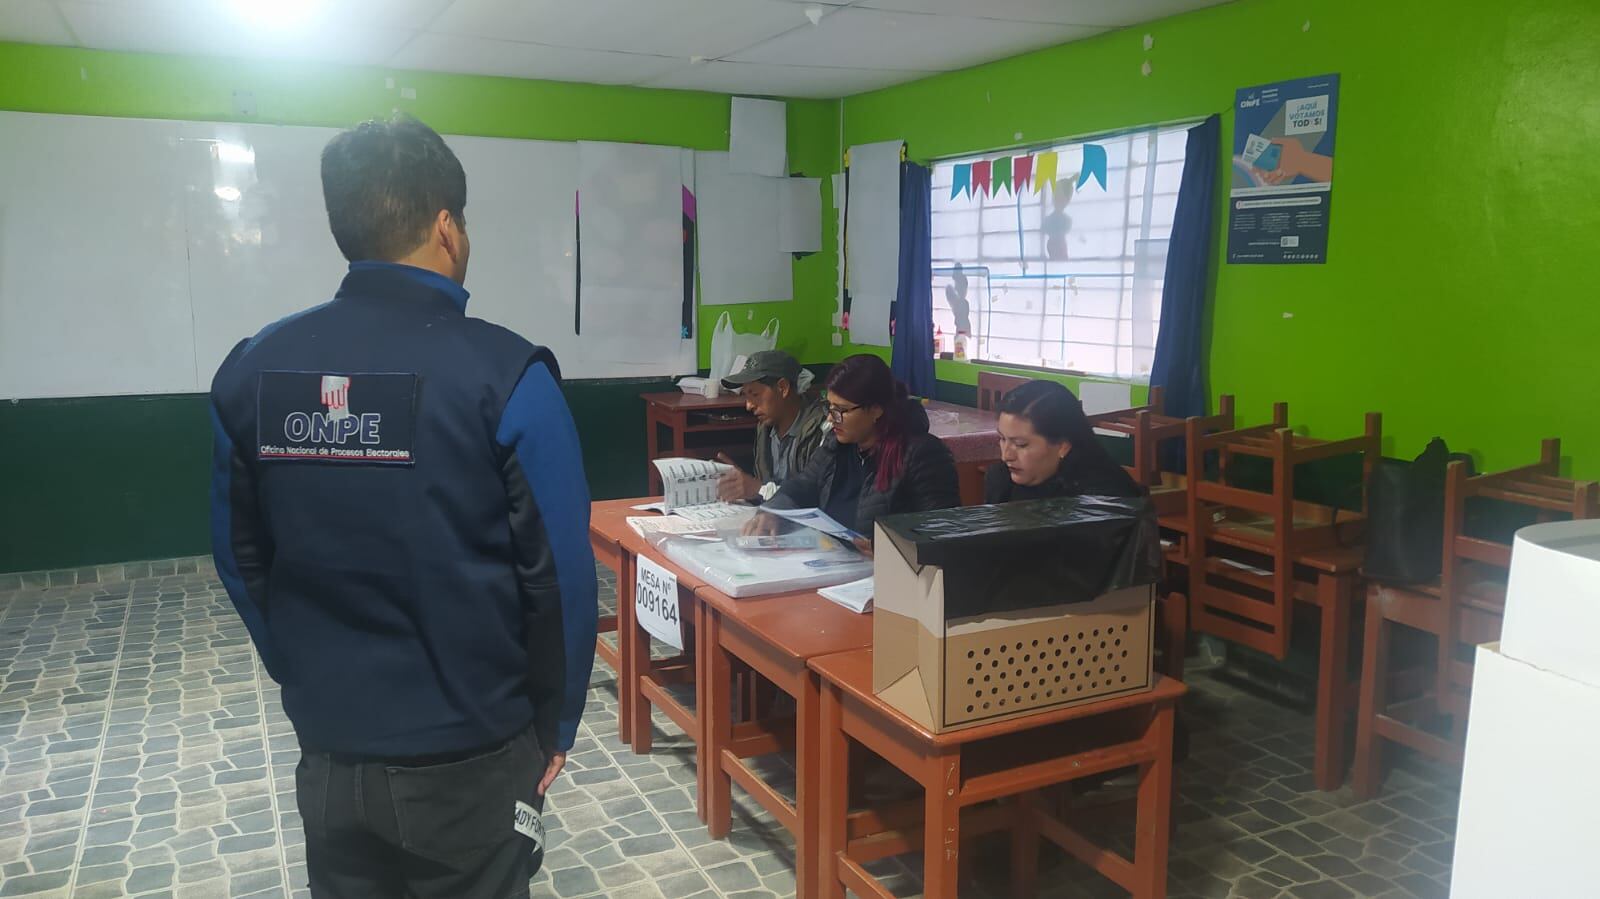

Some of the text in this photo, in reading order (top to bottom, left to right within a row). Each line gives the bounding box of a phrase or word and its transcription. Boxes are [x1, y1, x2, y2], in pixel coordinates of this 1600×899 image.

[1288, 109, 1325, 120] VOTAMOS
[1292, 117, 1323, 128] TODS!
[284, 411, 381, 444] ONPE
[260, 445, 410, 458] Oficina Nacional de Procesos Electorales
[641, 567, 660, 592] MESA
[637, 582, 677, 625] 009164
